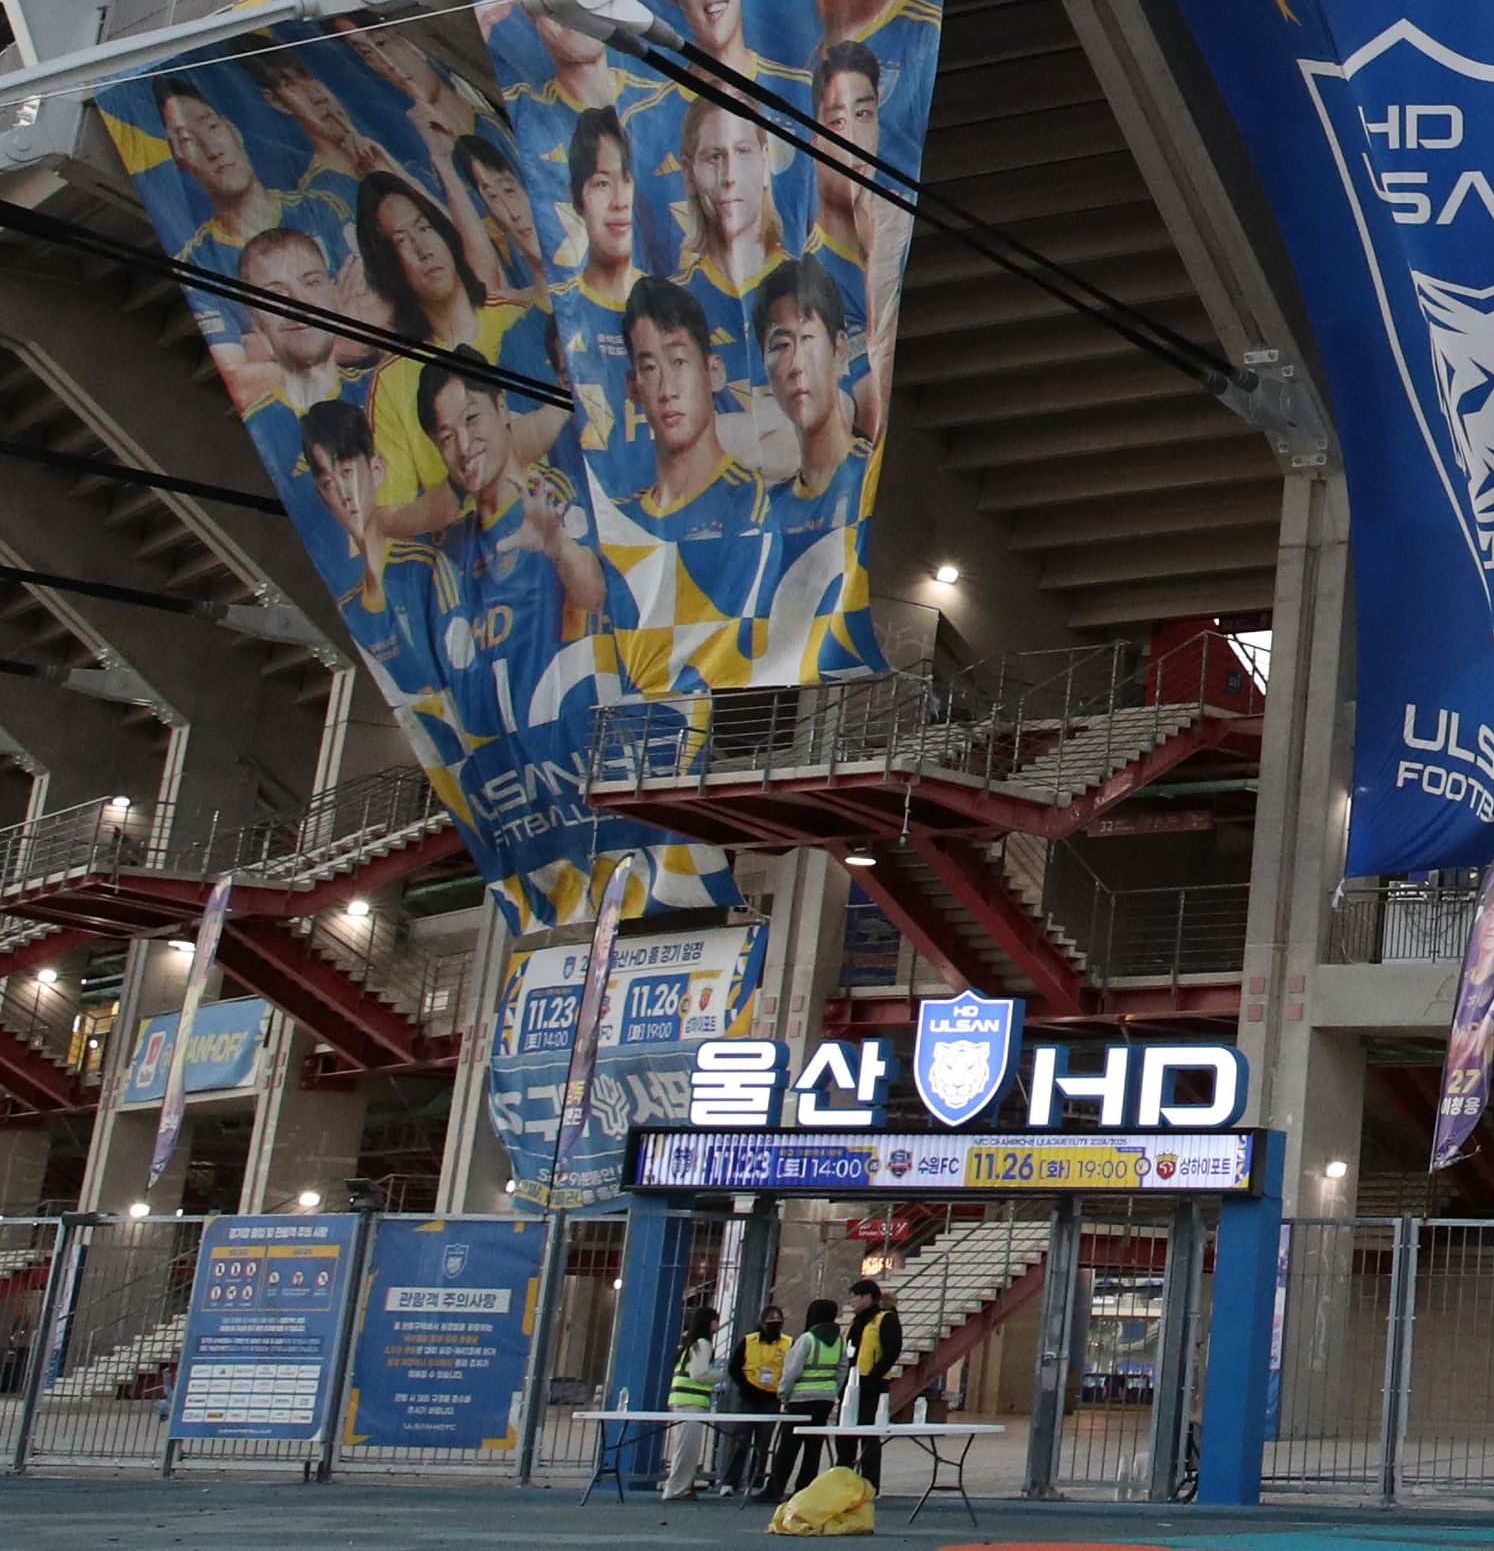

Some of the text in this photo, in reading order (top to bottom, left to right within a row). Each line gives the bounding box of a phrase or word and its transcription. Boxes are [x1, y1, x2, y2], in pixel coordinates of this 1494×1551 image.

[1358, 104, 1464, 149] HD
[629, 947, 647, 966] HD
[660, 944, 681, 964] 경기
[682, 941, 704, 961] 일정
[631, 983, 681, 1018] 11.26
[954, 1006, 978, 1017] HD
[528, 996, 576, 1031] 11.23
[930, 1019, 999, 1033] ULSAN
[542, 1031, 568, 1047] 14:00
[646, 1021, 672, 1039] 19:00
[690, 1041, 887, 1126] 울산
[1029, 1047, 1238, 1126] HD
[1447, 1069, 1481, 1094] 27
[712, 1151, 861, 1179] 11.23 [토] 14:00
[918, 1157, 959, 1175] 수원FC
[973, 1152, 1128, 1180] 11.26 [화] 19:00
[1180, 1156, 1231, 1176] 상하이포트
[399, 1292, 497, 1308] 관람객 주의사항
